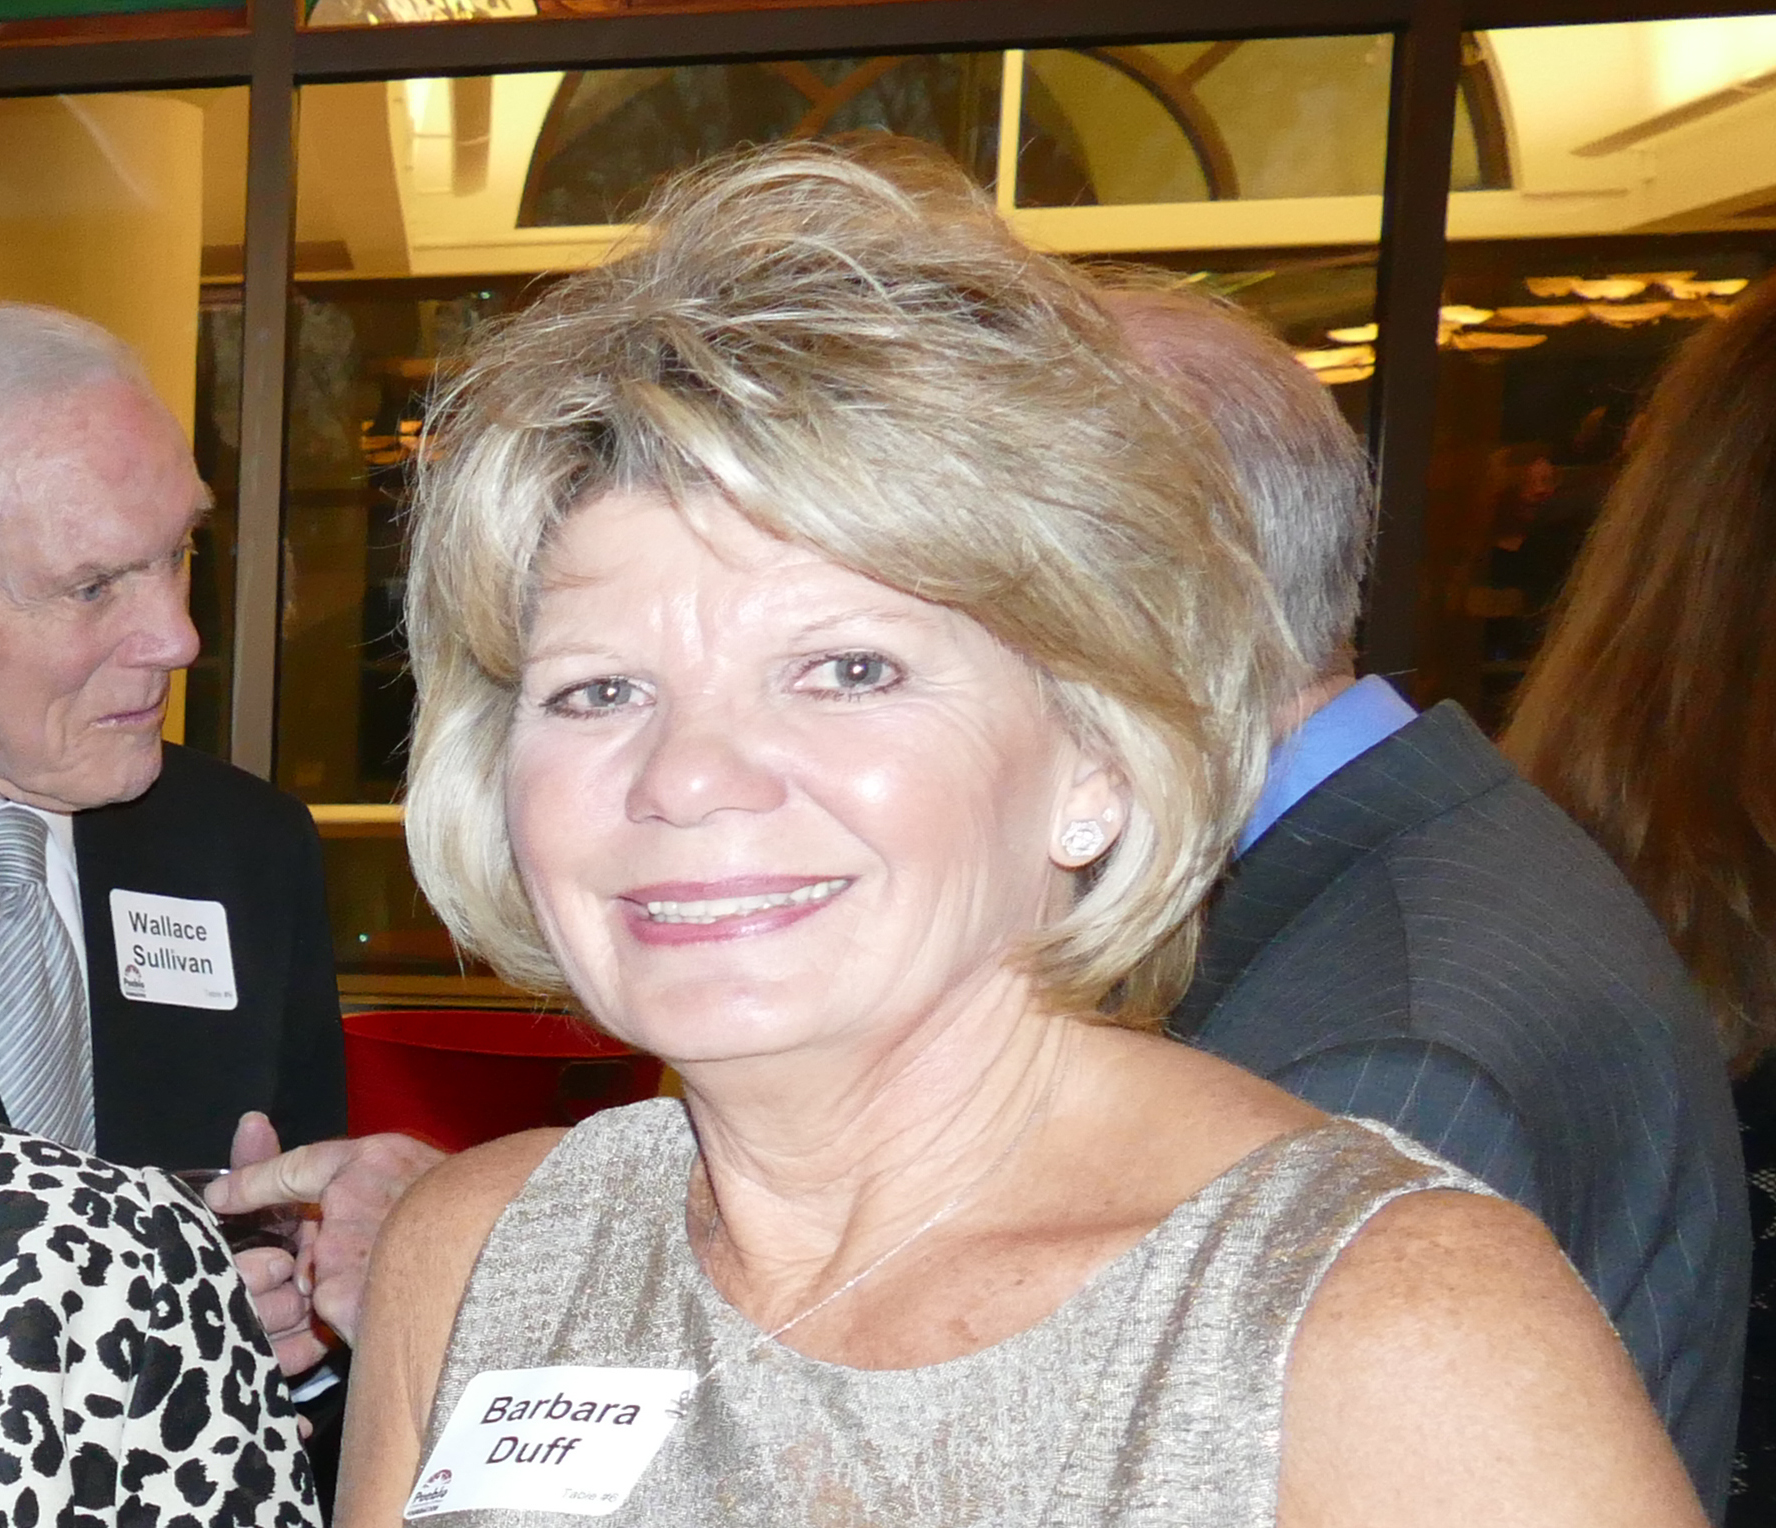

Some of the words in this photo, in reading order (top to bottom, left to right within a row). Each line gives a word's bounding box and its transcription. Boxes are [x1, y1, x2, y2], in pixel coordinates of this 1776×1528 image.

[128, 910, 207, 942] Wallace
[132, 944, 213, 975] Sullivan
[480, 1392, 641, 1425] Barbara
[485, 1436, 583, 1465] Duff
